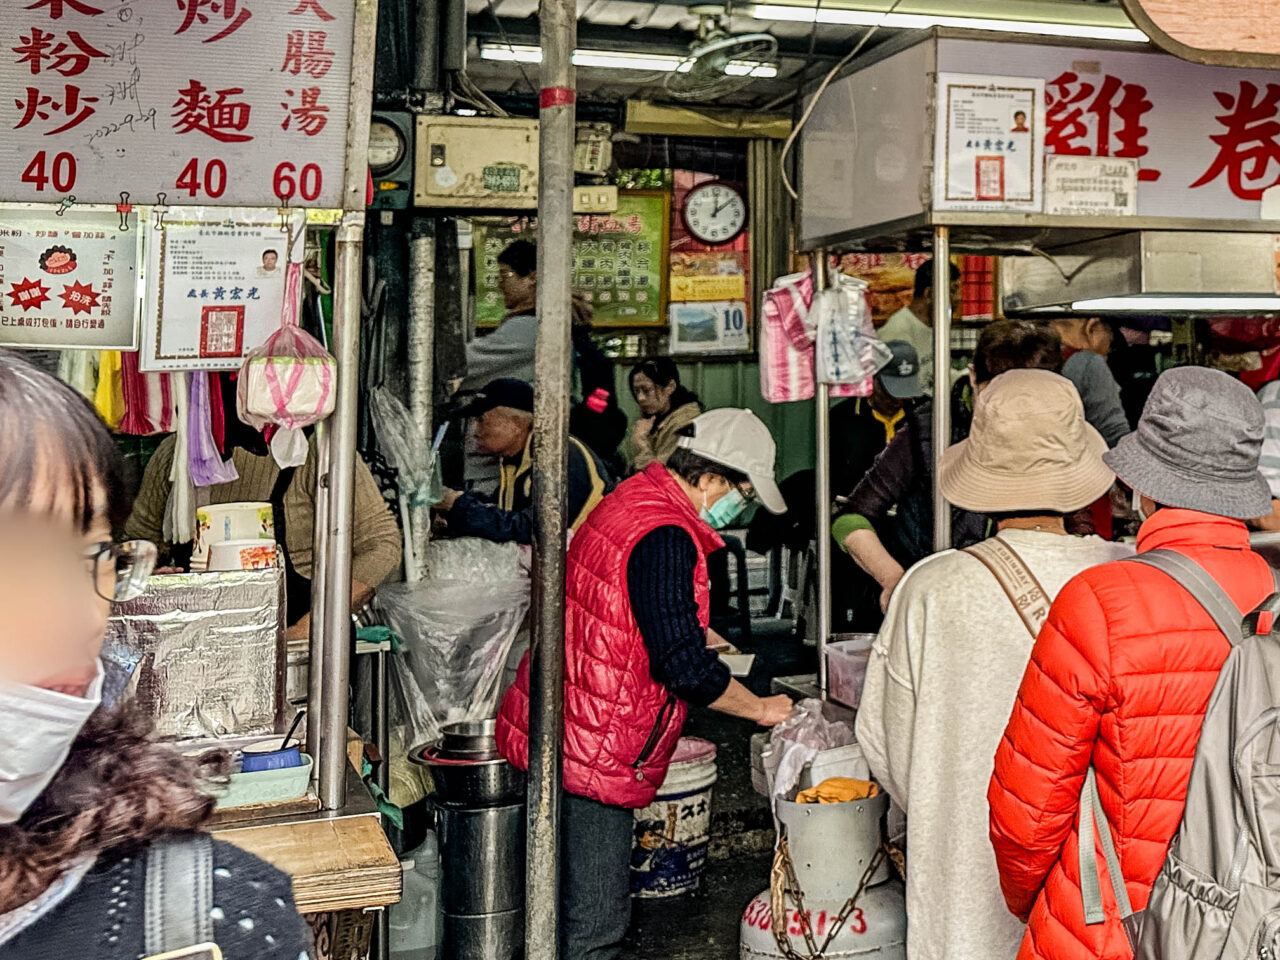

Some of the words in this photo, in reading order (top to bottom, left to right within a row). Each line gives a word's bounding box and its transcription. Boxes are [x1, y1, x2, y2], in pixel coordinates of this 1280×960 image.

[21, 151, 77, 192] 40
[175, 158, 227, 198] 40
[272, 162, 323, 201] 60
[723, 308, 744, 331] 10
